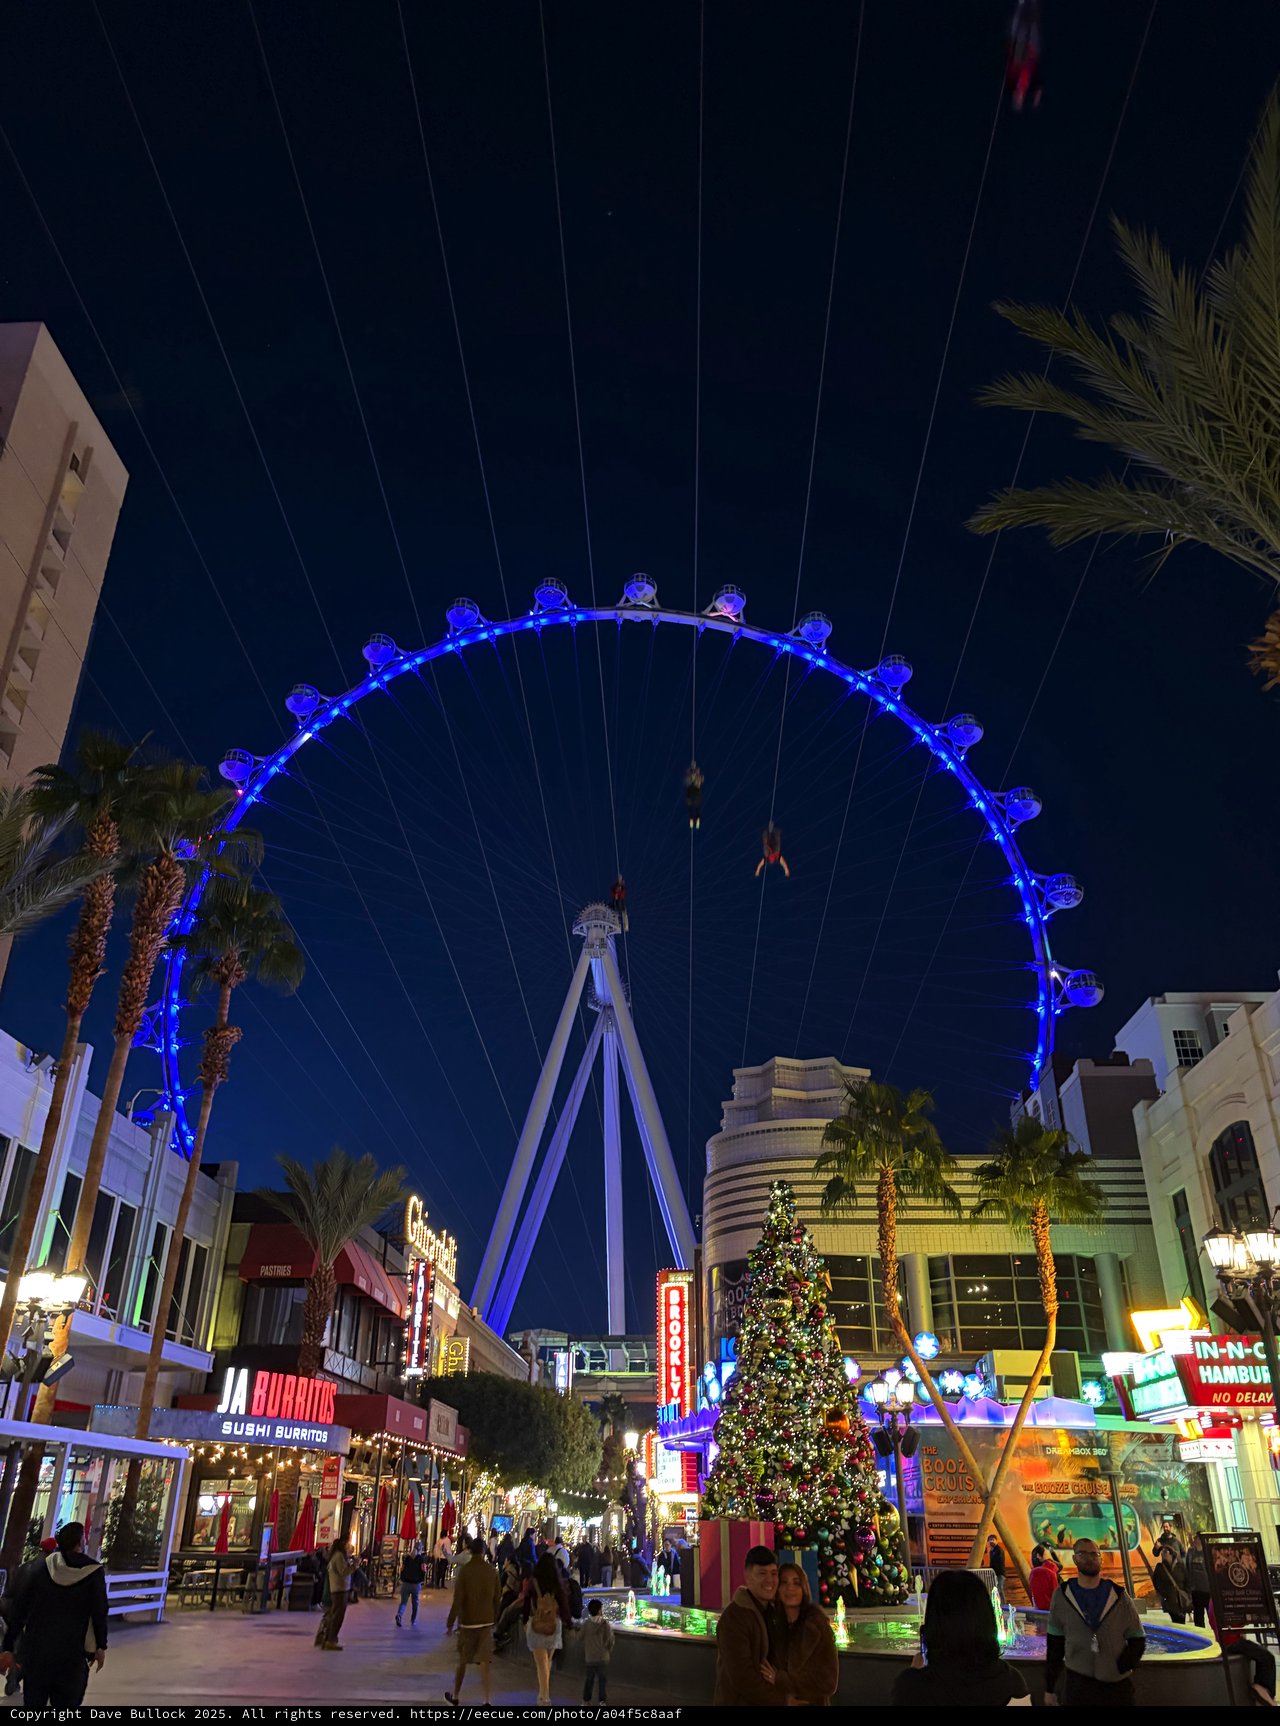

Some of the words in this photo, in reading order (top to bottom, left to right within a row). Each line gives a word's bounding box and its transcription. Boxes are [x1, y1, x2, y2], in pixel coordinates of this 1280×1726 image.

[405, 1195, 457, 1283] Ghirardelli
[260, 1265, 292, 1277] PASTRIES
[410, 1262, 426, 1368] FAVORITE
[1199, 1365, 1273, 1384] HAMBUR
[217, 1367, 248, 1415] JA
[251, 1370, 338, 1425] BURRITOS
[1212, 1392, 1231, 1403] NO
[221, 1421, 270, 1438] SUSHI
[275, 1425, 328, 1443] BURRITOS
[922, 1446, 938, 1455] THE
[1045, 1447, 1091, 1456] DREAMBOX
[922, 1459, 969, 1474] BOOZ
[924, 1475, 975, 1491] CRUIS
[1035, 1482, 1069, 1494] BOOZE
